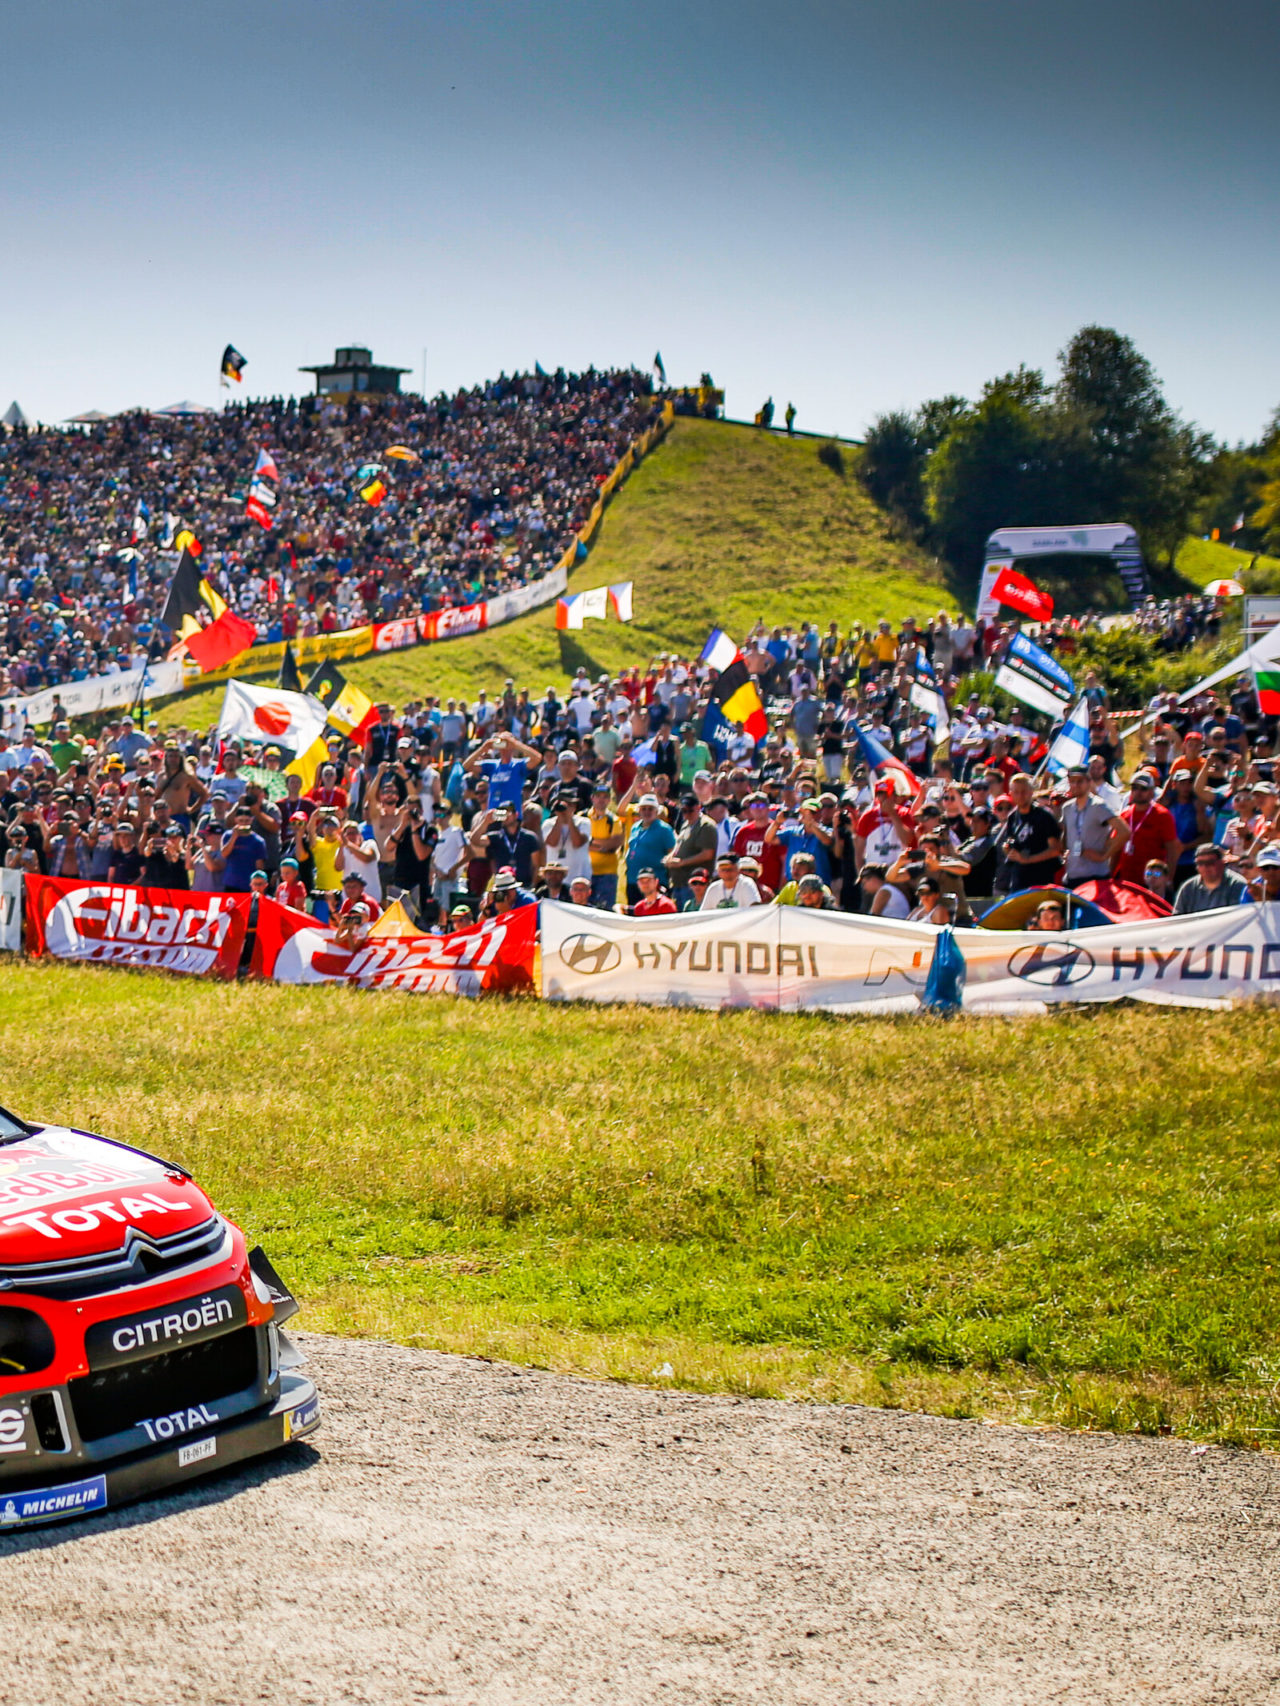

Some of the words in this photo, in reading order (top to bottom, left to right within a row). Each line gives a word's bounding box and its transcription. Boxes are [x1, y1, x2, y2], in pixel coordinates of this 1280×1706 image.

[45, 886, 232, 953] Eibach
[632, 940, 820, 977] HYUNDAI
[2, 1192, 193, 1239] TOTAL
[112, 1296, 234, 1352] CITROËN
[135, 1404, 219, 1442] TOTAL
[22, 1487, 99, 1516] MICHELIN
